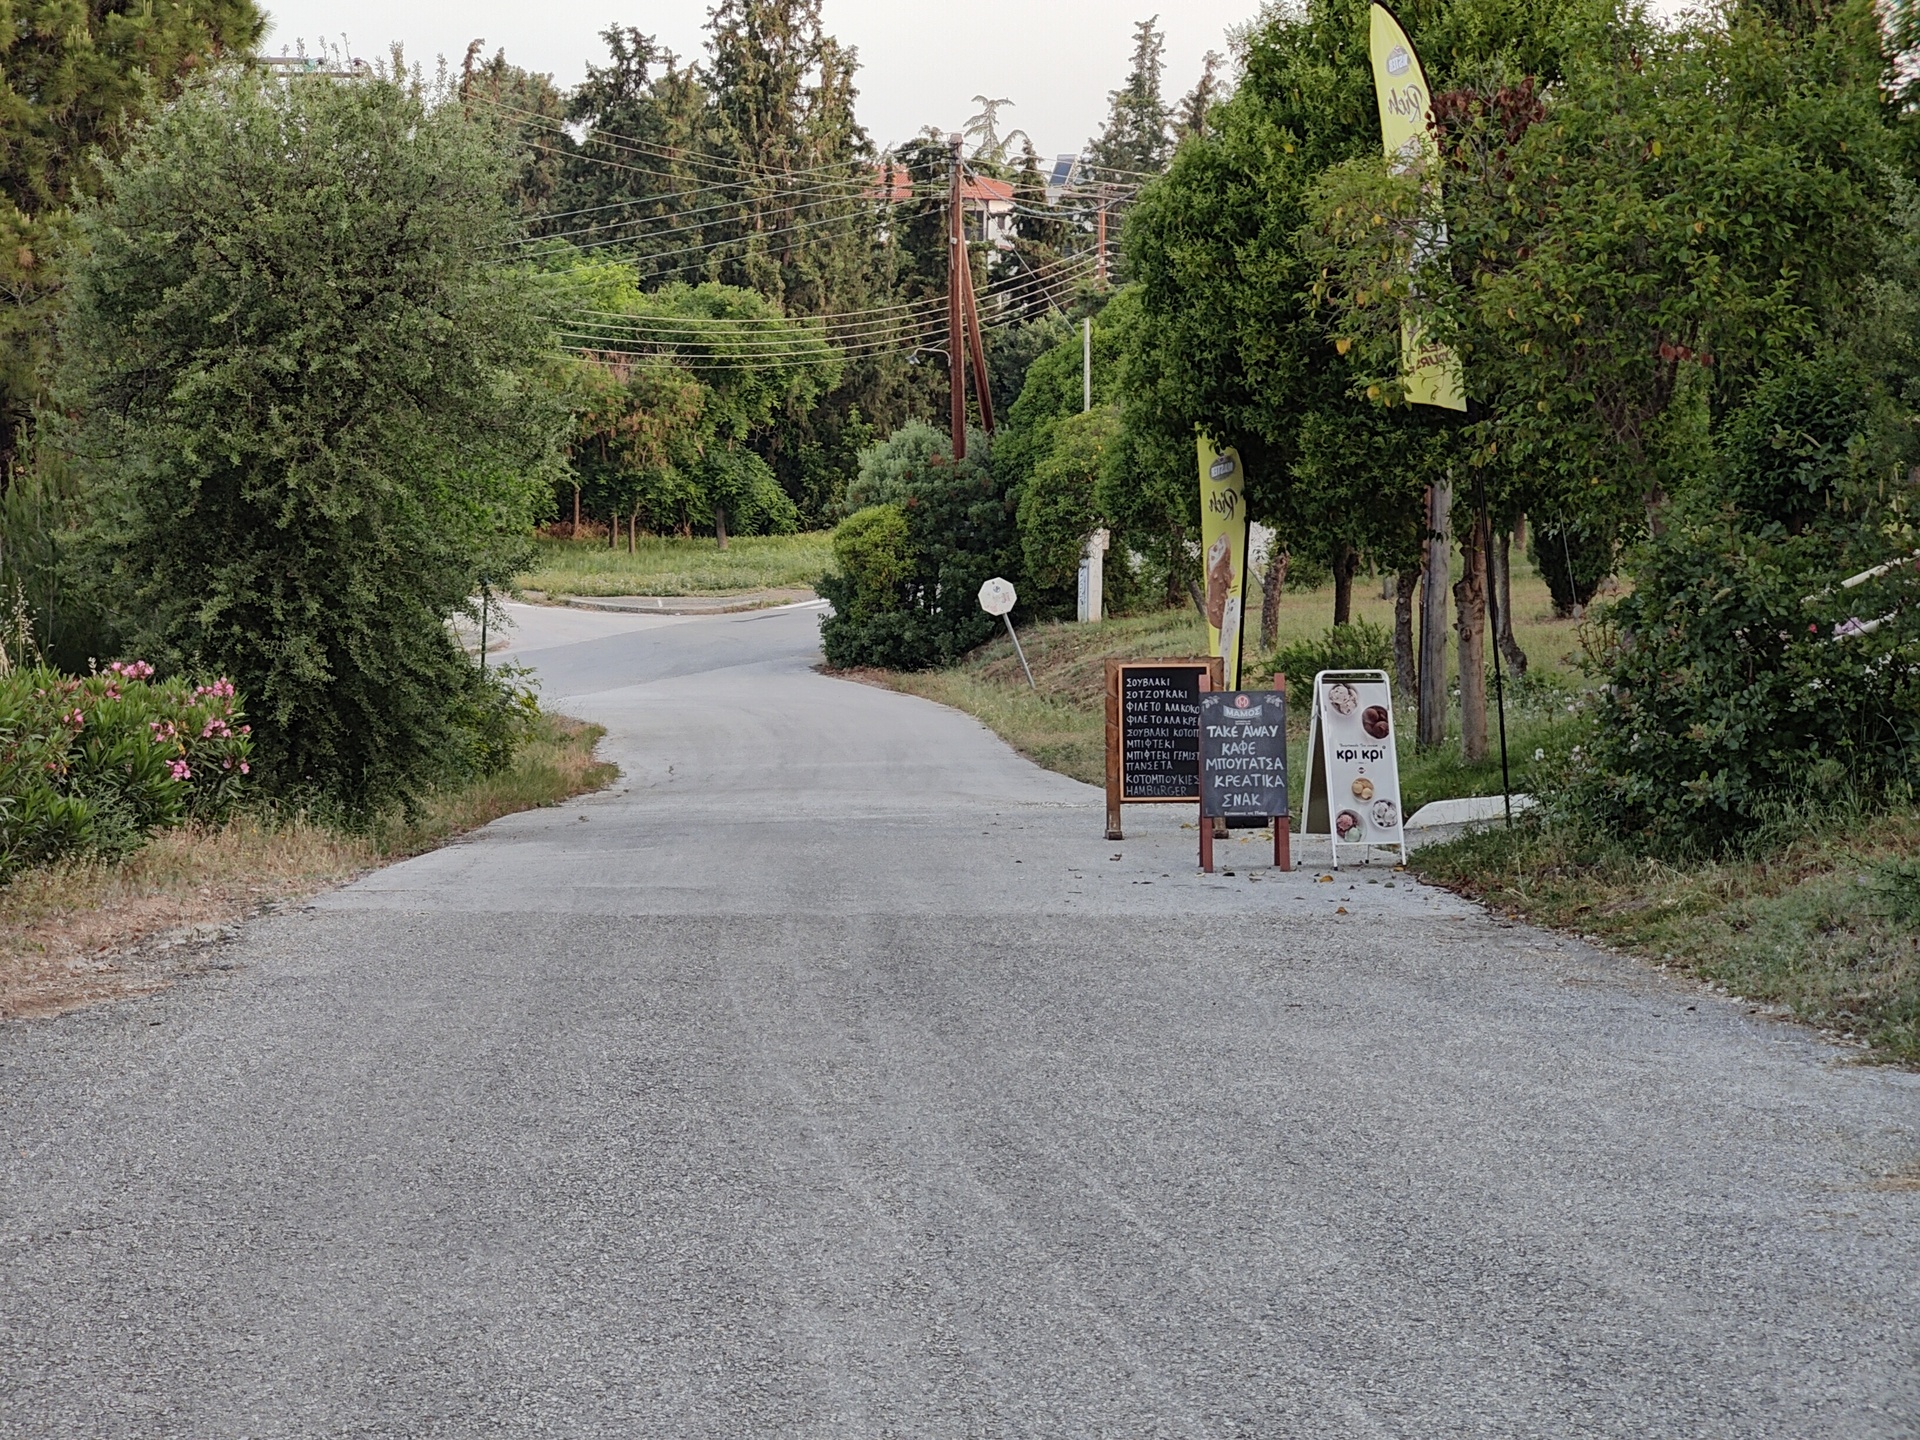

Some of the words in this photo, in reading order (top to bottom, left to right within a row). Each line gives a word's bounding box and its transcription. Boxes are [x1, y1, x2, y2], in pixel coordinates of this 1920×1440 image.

[1126, 677, 1170, 687] ΣΟΥΒΛΑΚΙ
[1126, 689, 1188, 699] ΣΟΤΖΟΥΚΑΚΙ
[1126, 701, 1161, 712] ΦΙΛΕΤΟ
[1226, 707, 1261, 717] ΜΑΜΟΣ
[1126, 728, 1169, 737] ΣΟΥΒΛΑΚΙ
[1206, 725, 1239, 738] TAKE
[1242, 725, 1279, 738] AWAY
[1126, 738, 1175, 749] ΜΠΙΦΤΕΚΙ
[1221, 740, 1256, 756] ΚΑΦΕ
[1126, 750, 1170, 761] ΜΠΙΦΤΕΚΙ
[1126, 761, 1173, 771] ΠΑΝΣΕΤΑ
[1205, 757, 1284, 771] ΜΠΟΥΓΑΤΣΑ
[1126, 773, 1200, 785] ΚΟΤΟΜΠΟΥΚΙΕΣ
[1214, 774, 1285, 788] ΚΡΕΑΤΙΚΑ
[1221, 793, 1262, 808] ΣΝΑΚ
